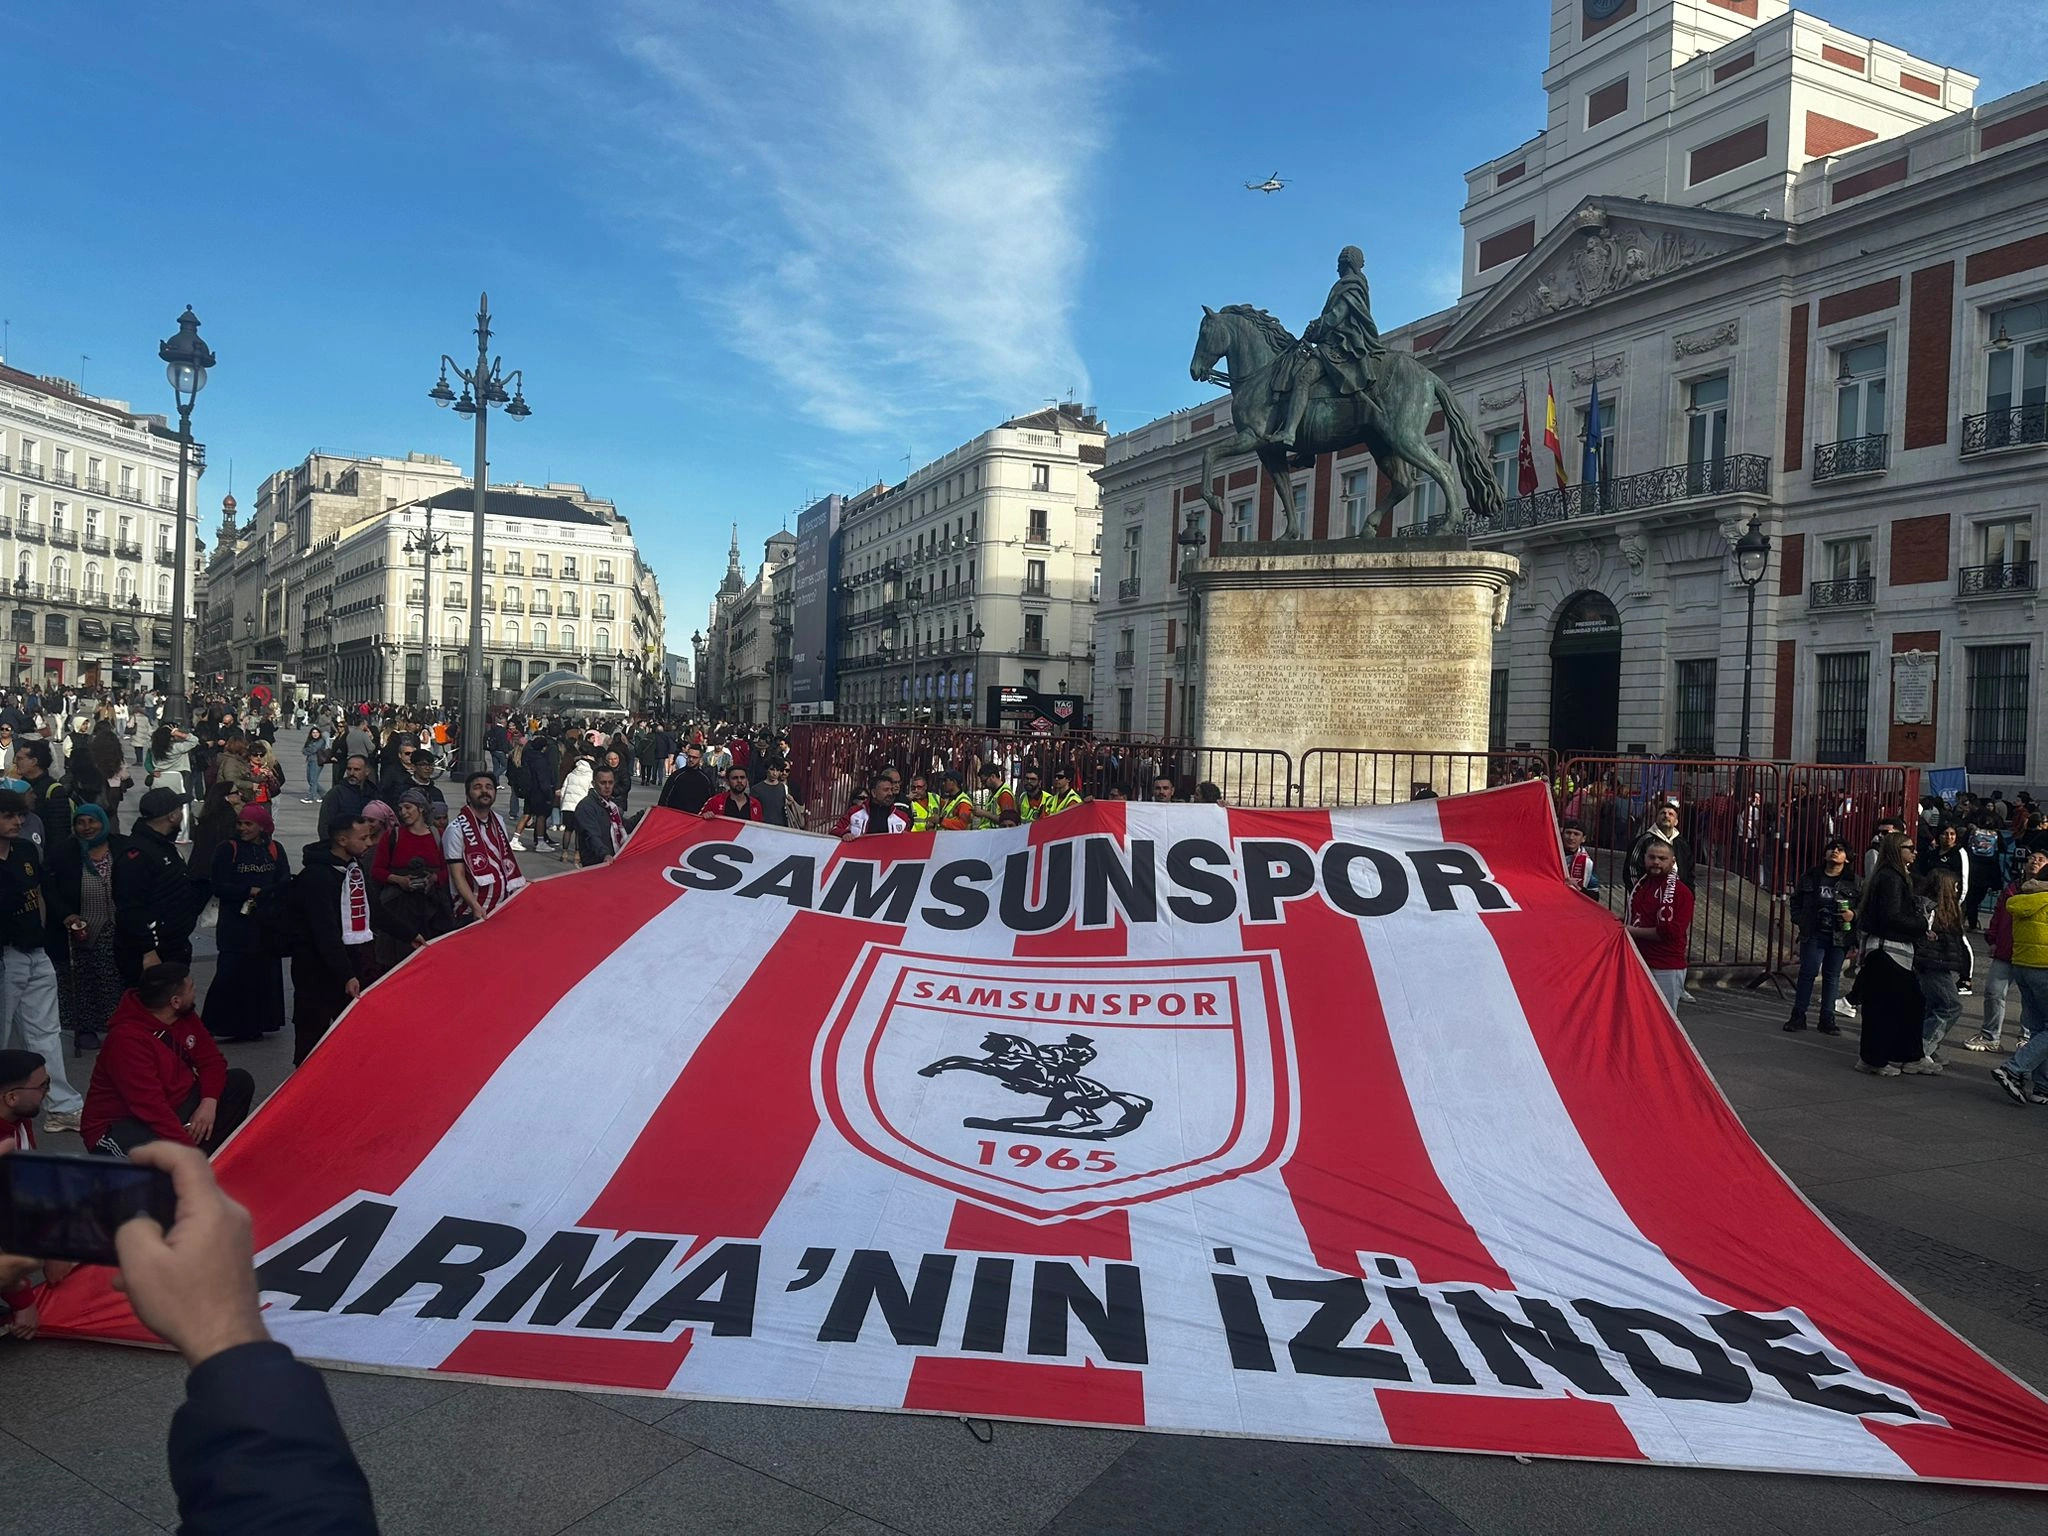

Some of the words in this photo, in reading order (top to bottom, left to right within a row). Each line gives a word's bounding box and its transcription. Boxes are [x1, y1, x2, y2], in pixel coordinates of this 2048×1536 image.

[1562, 627, 1590, 635] COMUNIDAD
[667, 836, 1511, 930] SAMSUNSPOR
[914, 981, 1218, 1016] SAMSUNSPOR
[977, 1140, 1117, 1173] 1965
